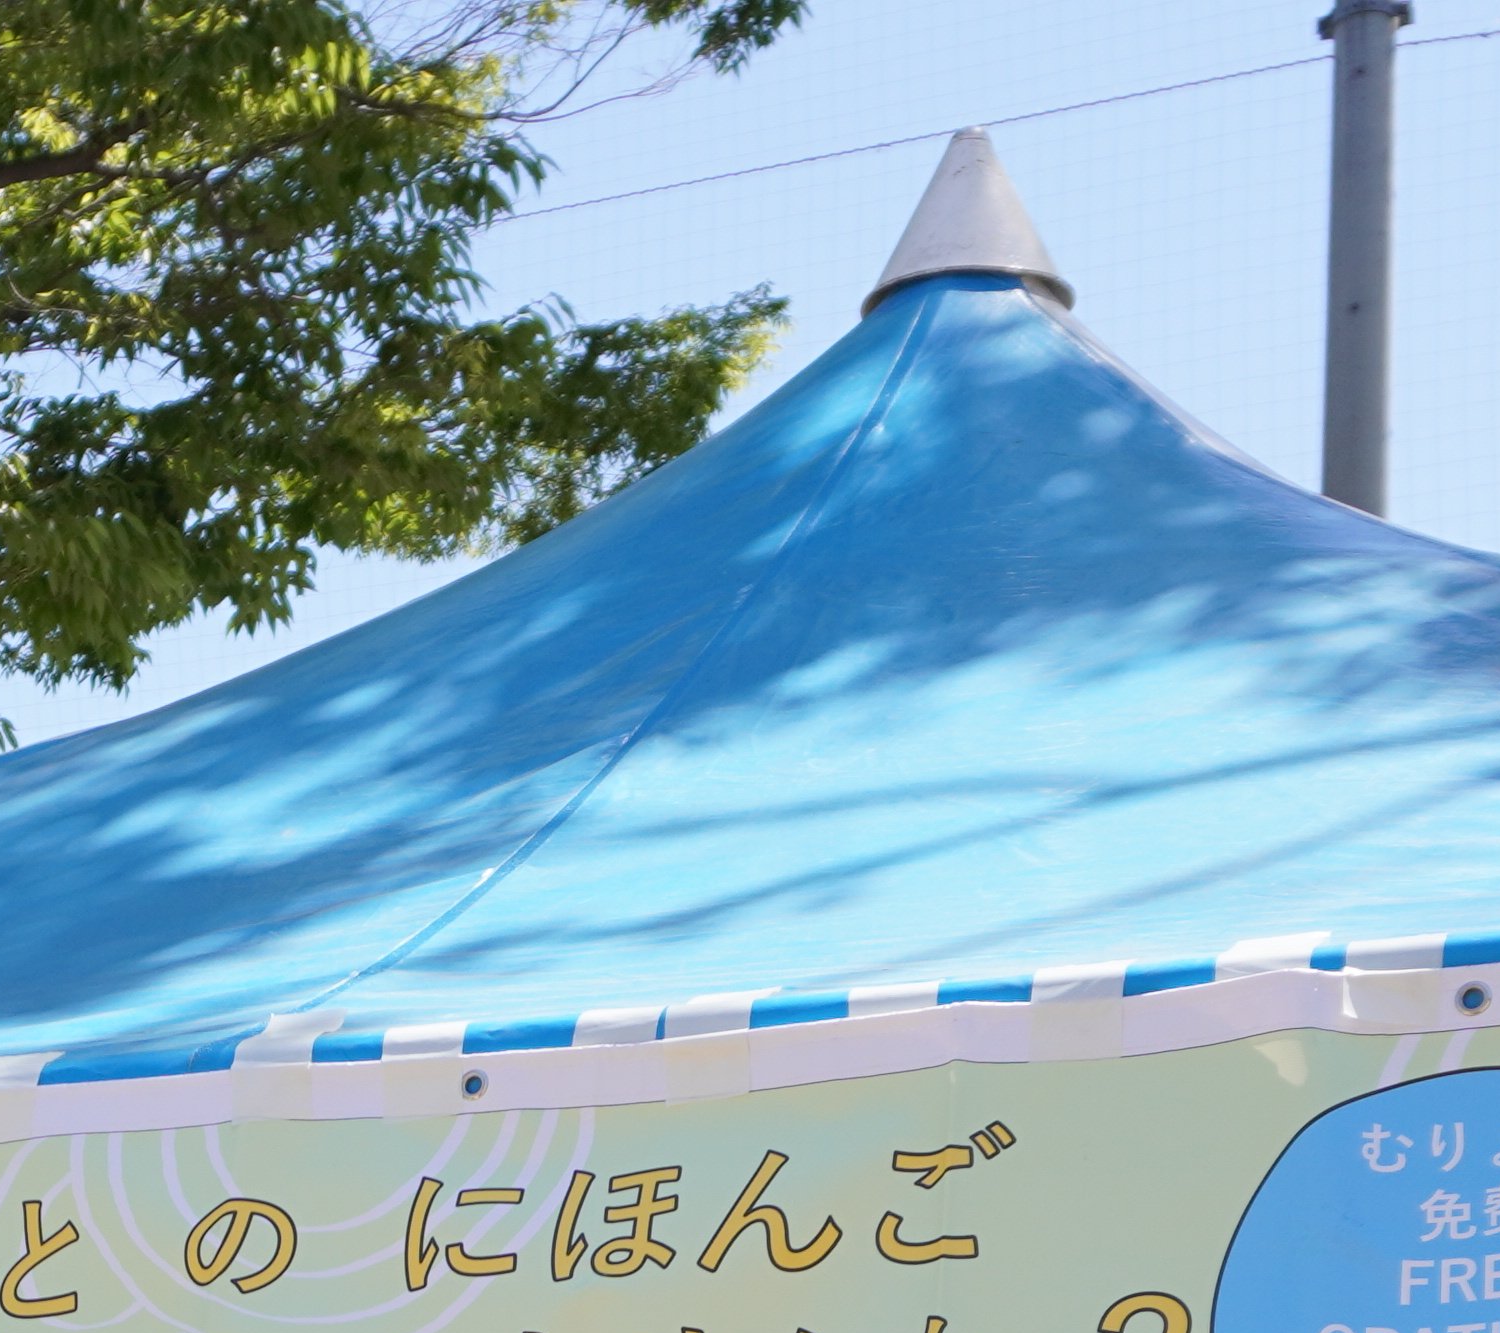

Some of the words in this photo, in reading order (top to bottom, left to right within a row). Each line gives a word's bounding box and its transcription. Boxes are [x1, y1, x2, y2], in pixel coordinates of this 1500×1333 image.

[184, 1197, 298, 1294] の
[404, 1120, 1017, 1291] にほんご
